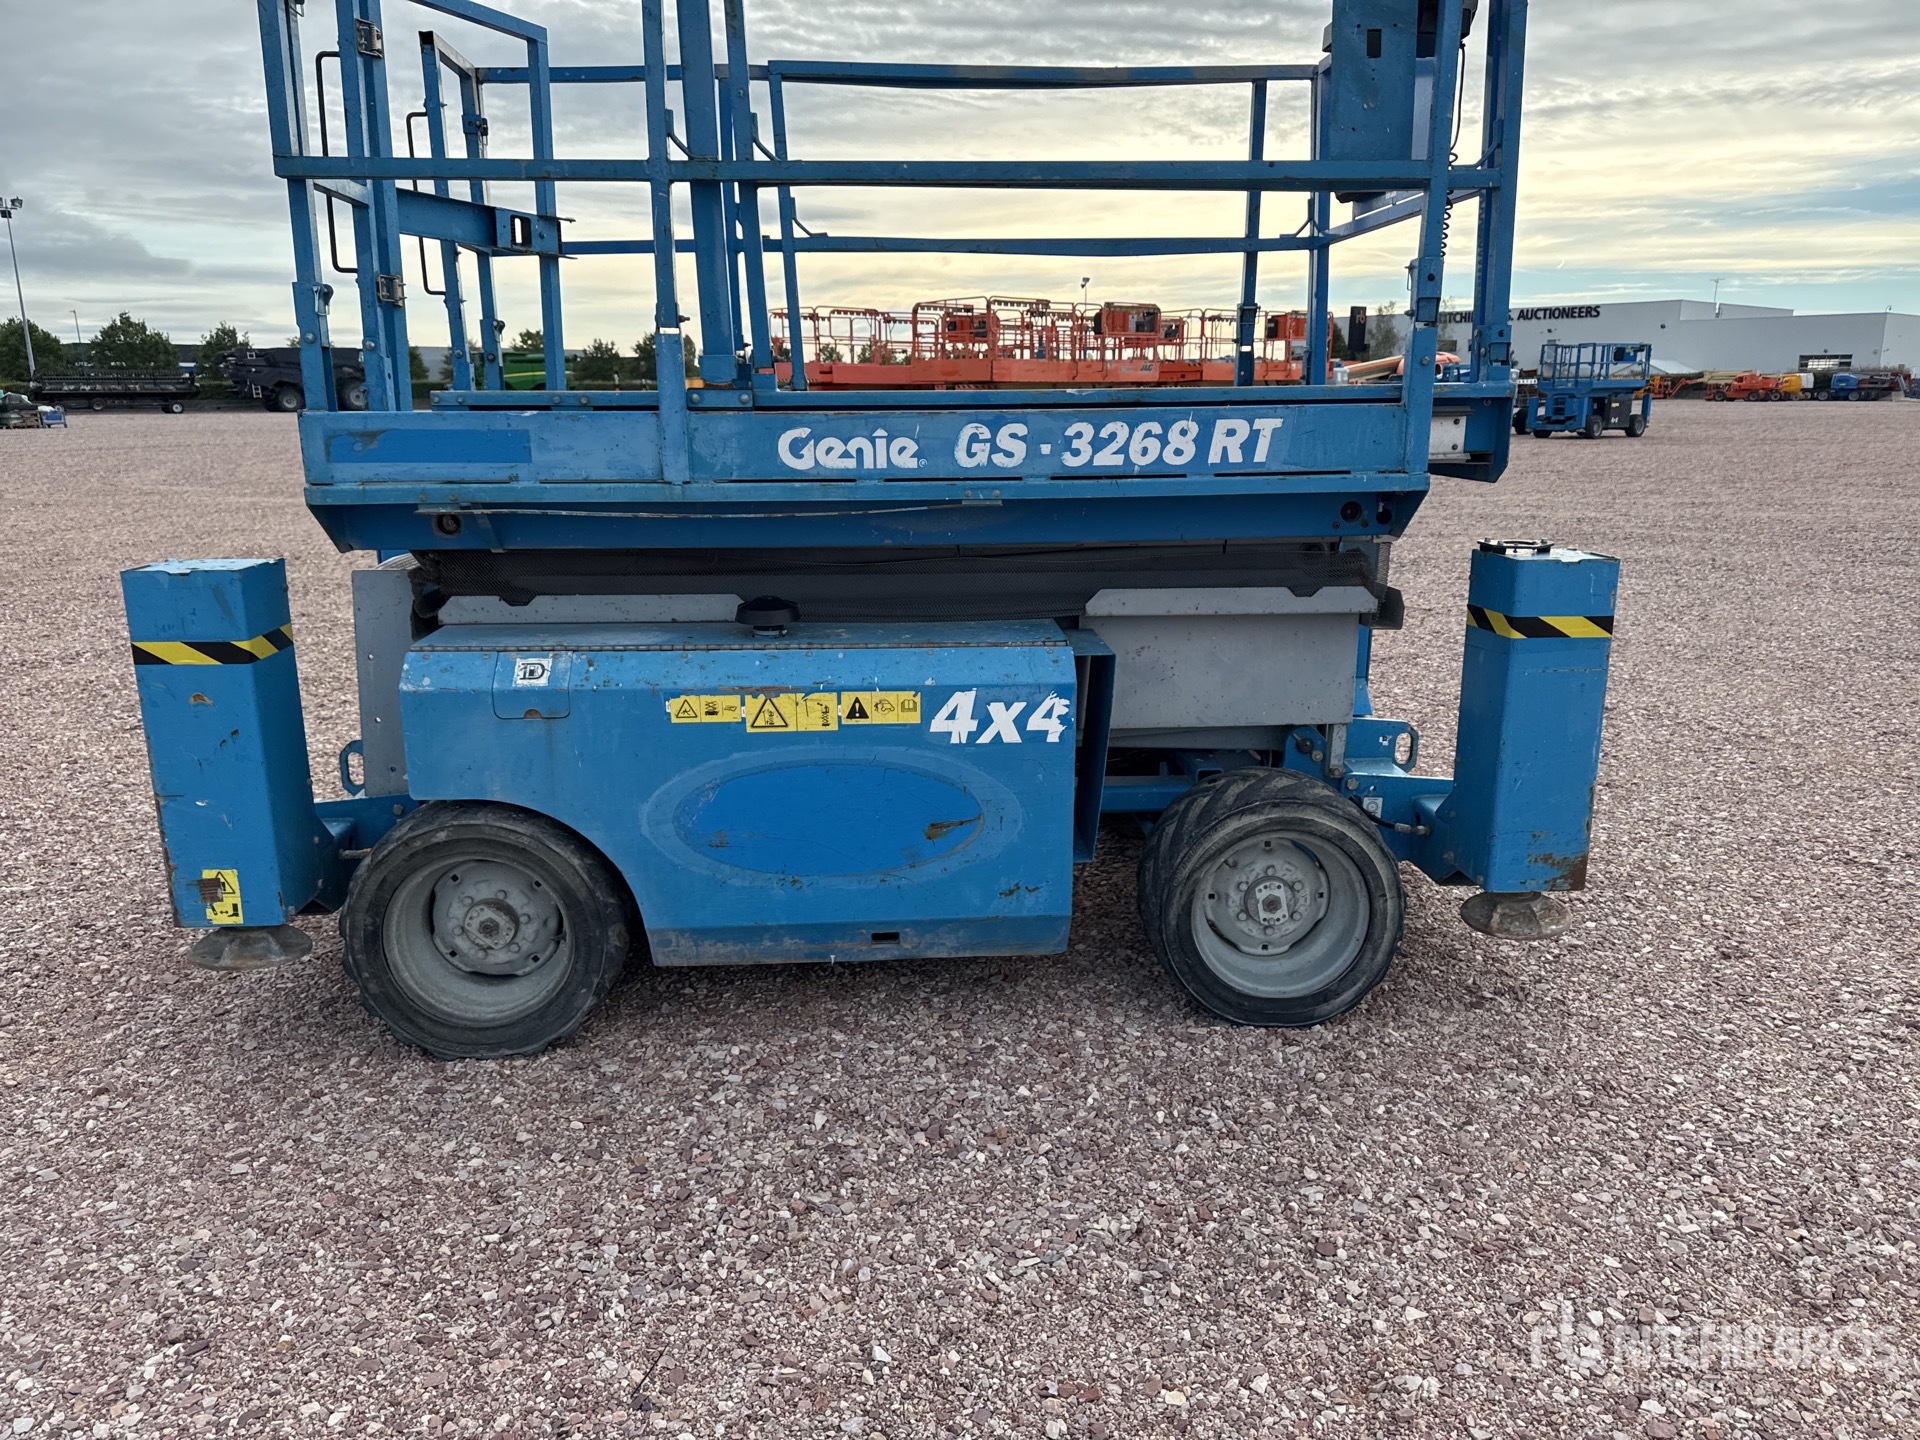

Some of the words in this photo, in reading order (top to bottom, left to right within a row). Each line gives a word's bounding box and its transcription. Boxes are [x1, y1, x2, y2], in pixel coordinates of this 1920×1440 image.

[1517, 305, 1601, 321] AUCTIONEERS
[778, 427, 920, 469] Genie
[953, 422, 1029, 468] GS
[1061, 418, 1199, 467] 3268
[1207, 417, 1283, 463] RT
[929, 688, 1071, 744] 4x4
